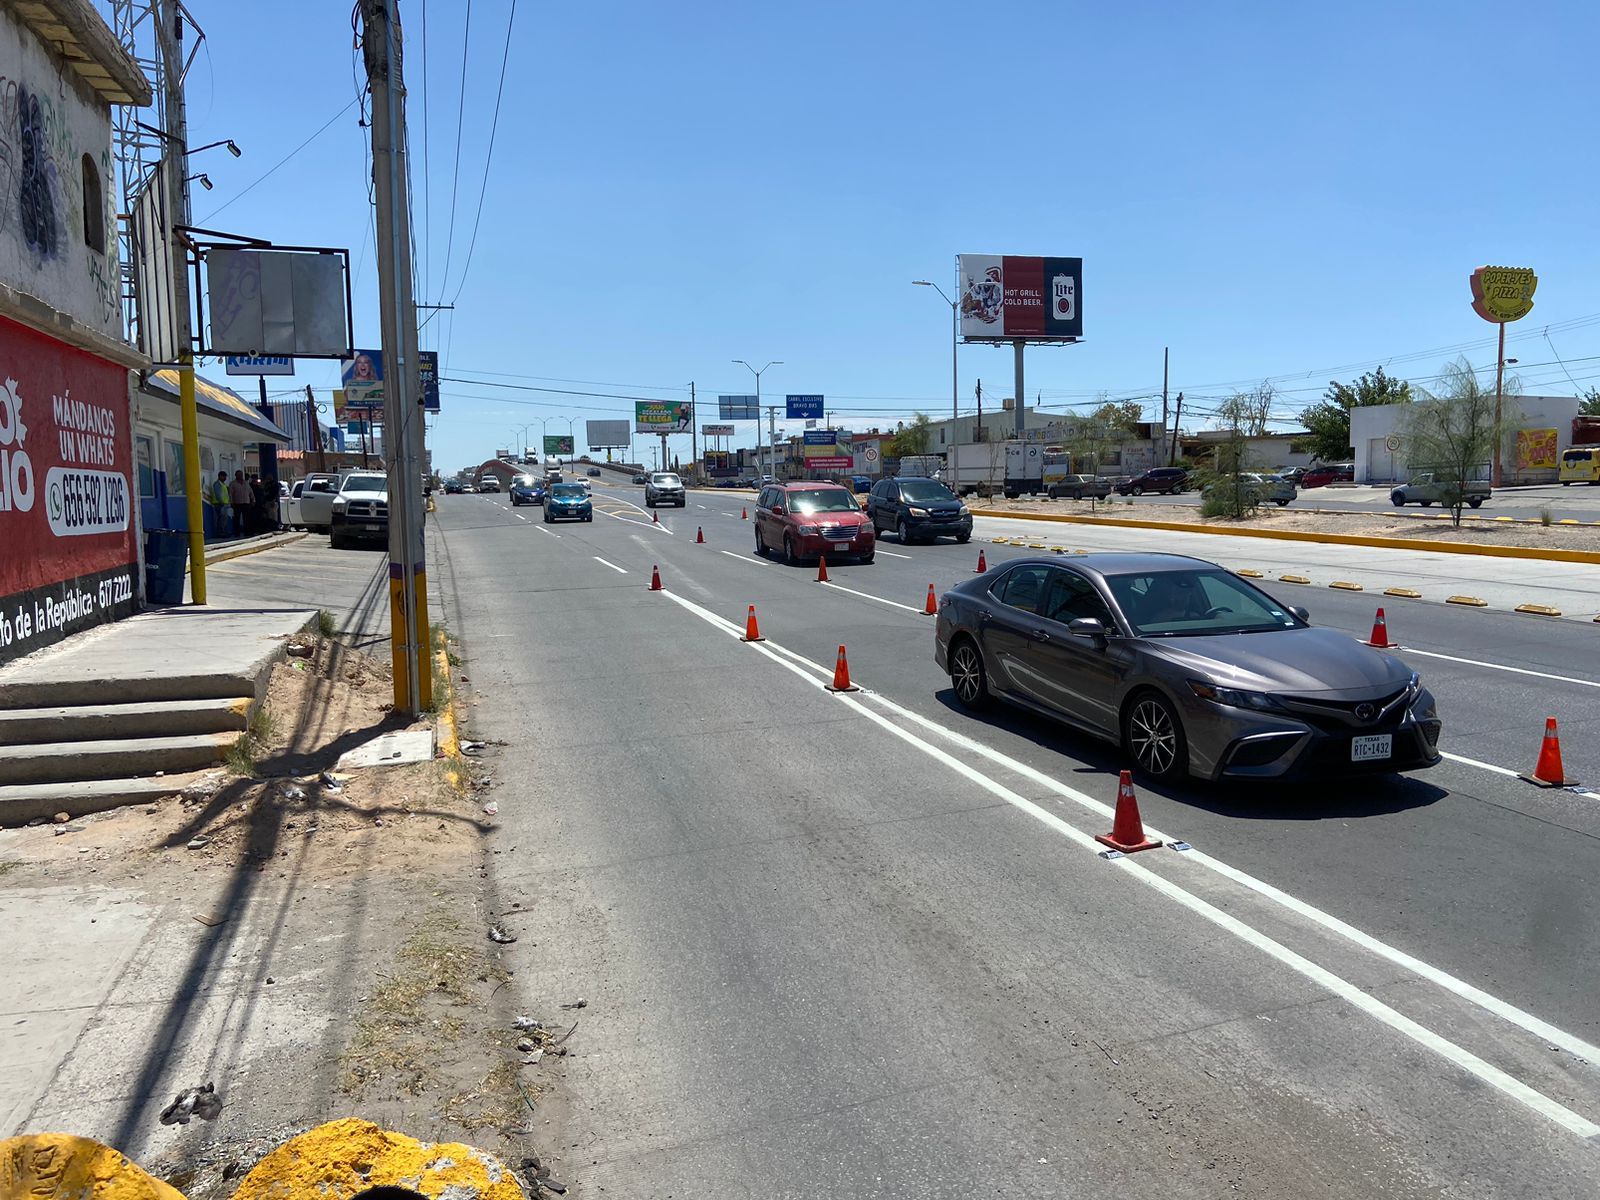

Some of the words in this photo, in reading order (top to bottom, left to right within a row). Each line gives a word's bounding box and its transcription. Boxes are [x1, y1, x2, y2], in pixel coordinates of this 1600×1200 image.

[1054, 283, 1074, 298] Lite
[1484, 271, 1531, 284] POPER-YES
[1493, 287, 1519, 298] PIZZA
[1004, 298, 1021, 306] COLD
[52, 389, 115, 438] MÁNDANOS
[59, 429, 76, 463] UN
[77, 432, 115, 466] WHATS
[0, 449, 35, 513] IO
[62, 473, 85, 528] 656
[83, 474, 103, 526] 592
[103, 476, 125, 524] 1296
[15, 605, 32, 640] de
[34, 601, 46, 634] la
[99, 579, 113, 609] 617
